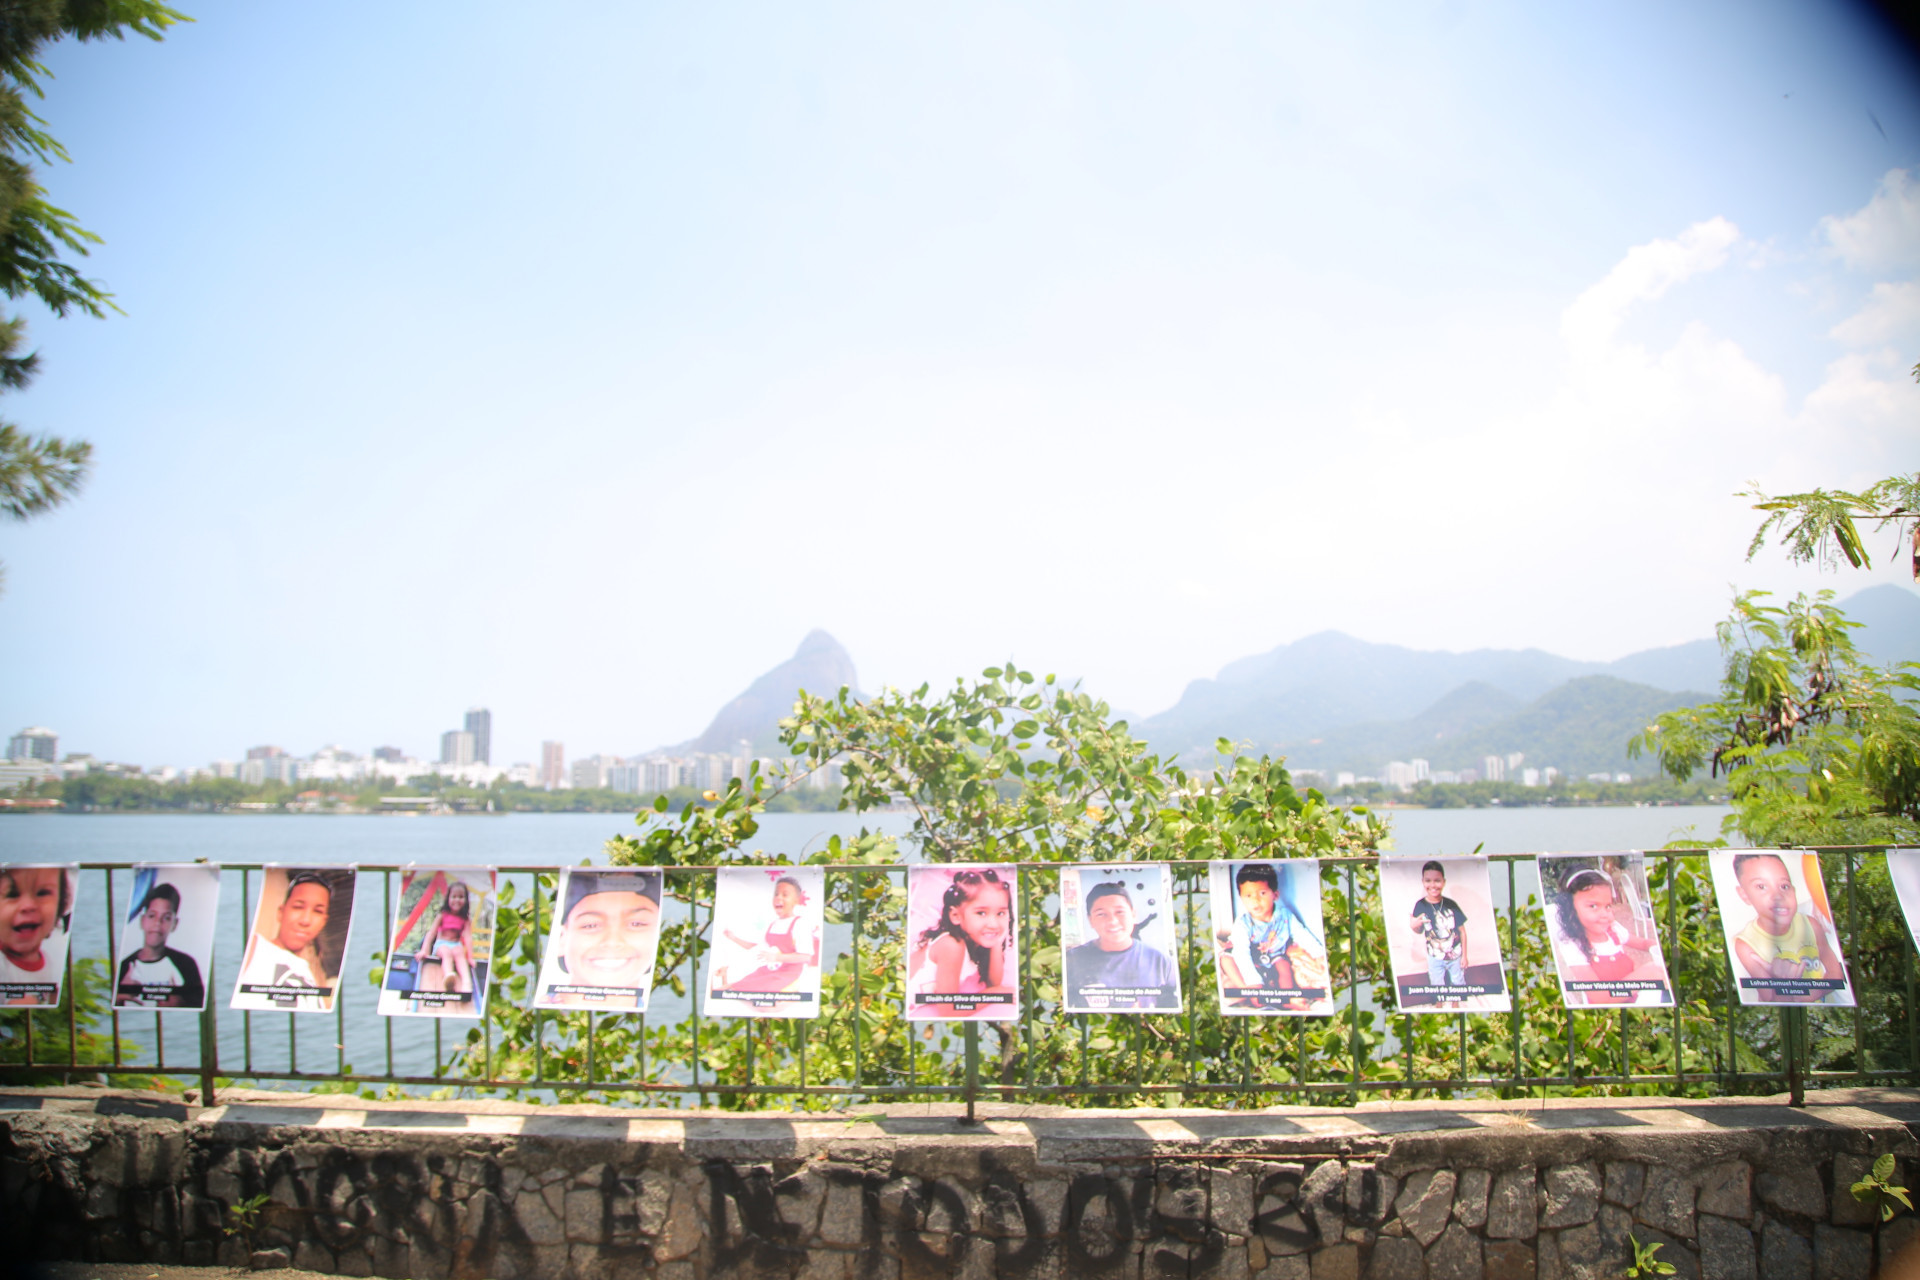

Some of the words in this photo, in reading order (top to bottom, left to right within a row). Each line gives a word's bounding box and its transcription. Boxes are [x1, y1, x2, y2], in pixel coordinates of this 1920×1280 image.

[1593, 982, 1615, 990] Vitória
[602, 988, 636, 996] Gonçalves
[738, 992, 765, 1000] Augusto
[765, 992, 774, 1000] de
[774, 992, 801, 1000] Amorim
[816, 1150, 1226, 1277] TODOS
